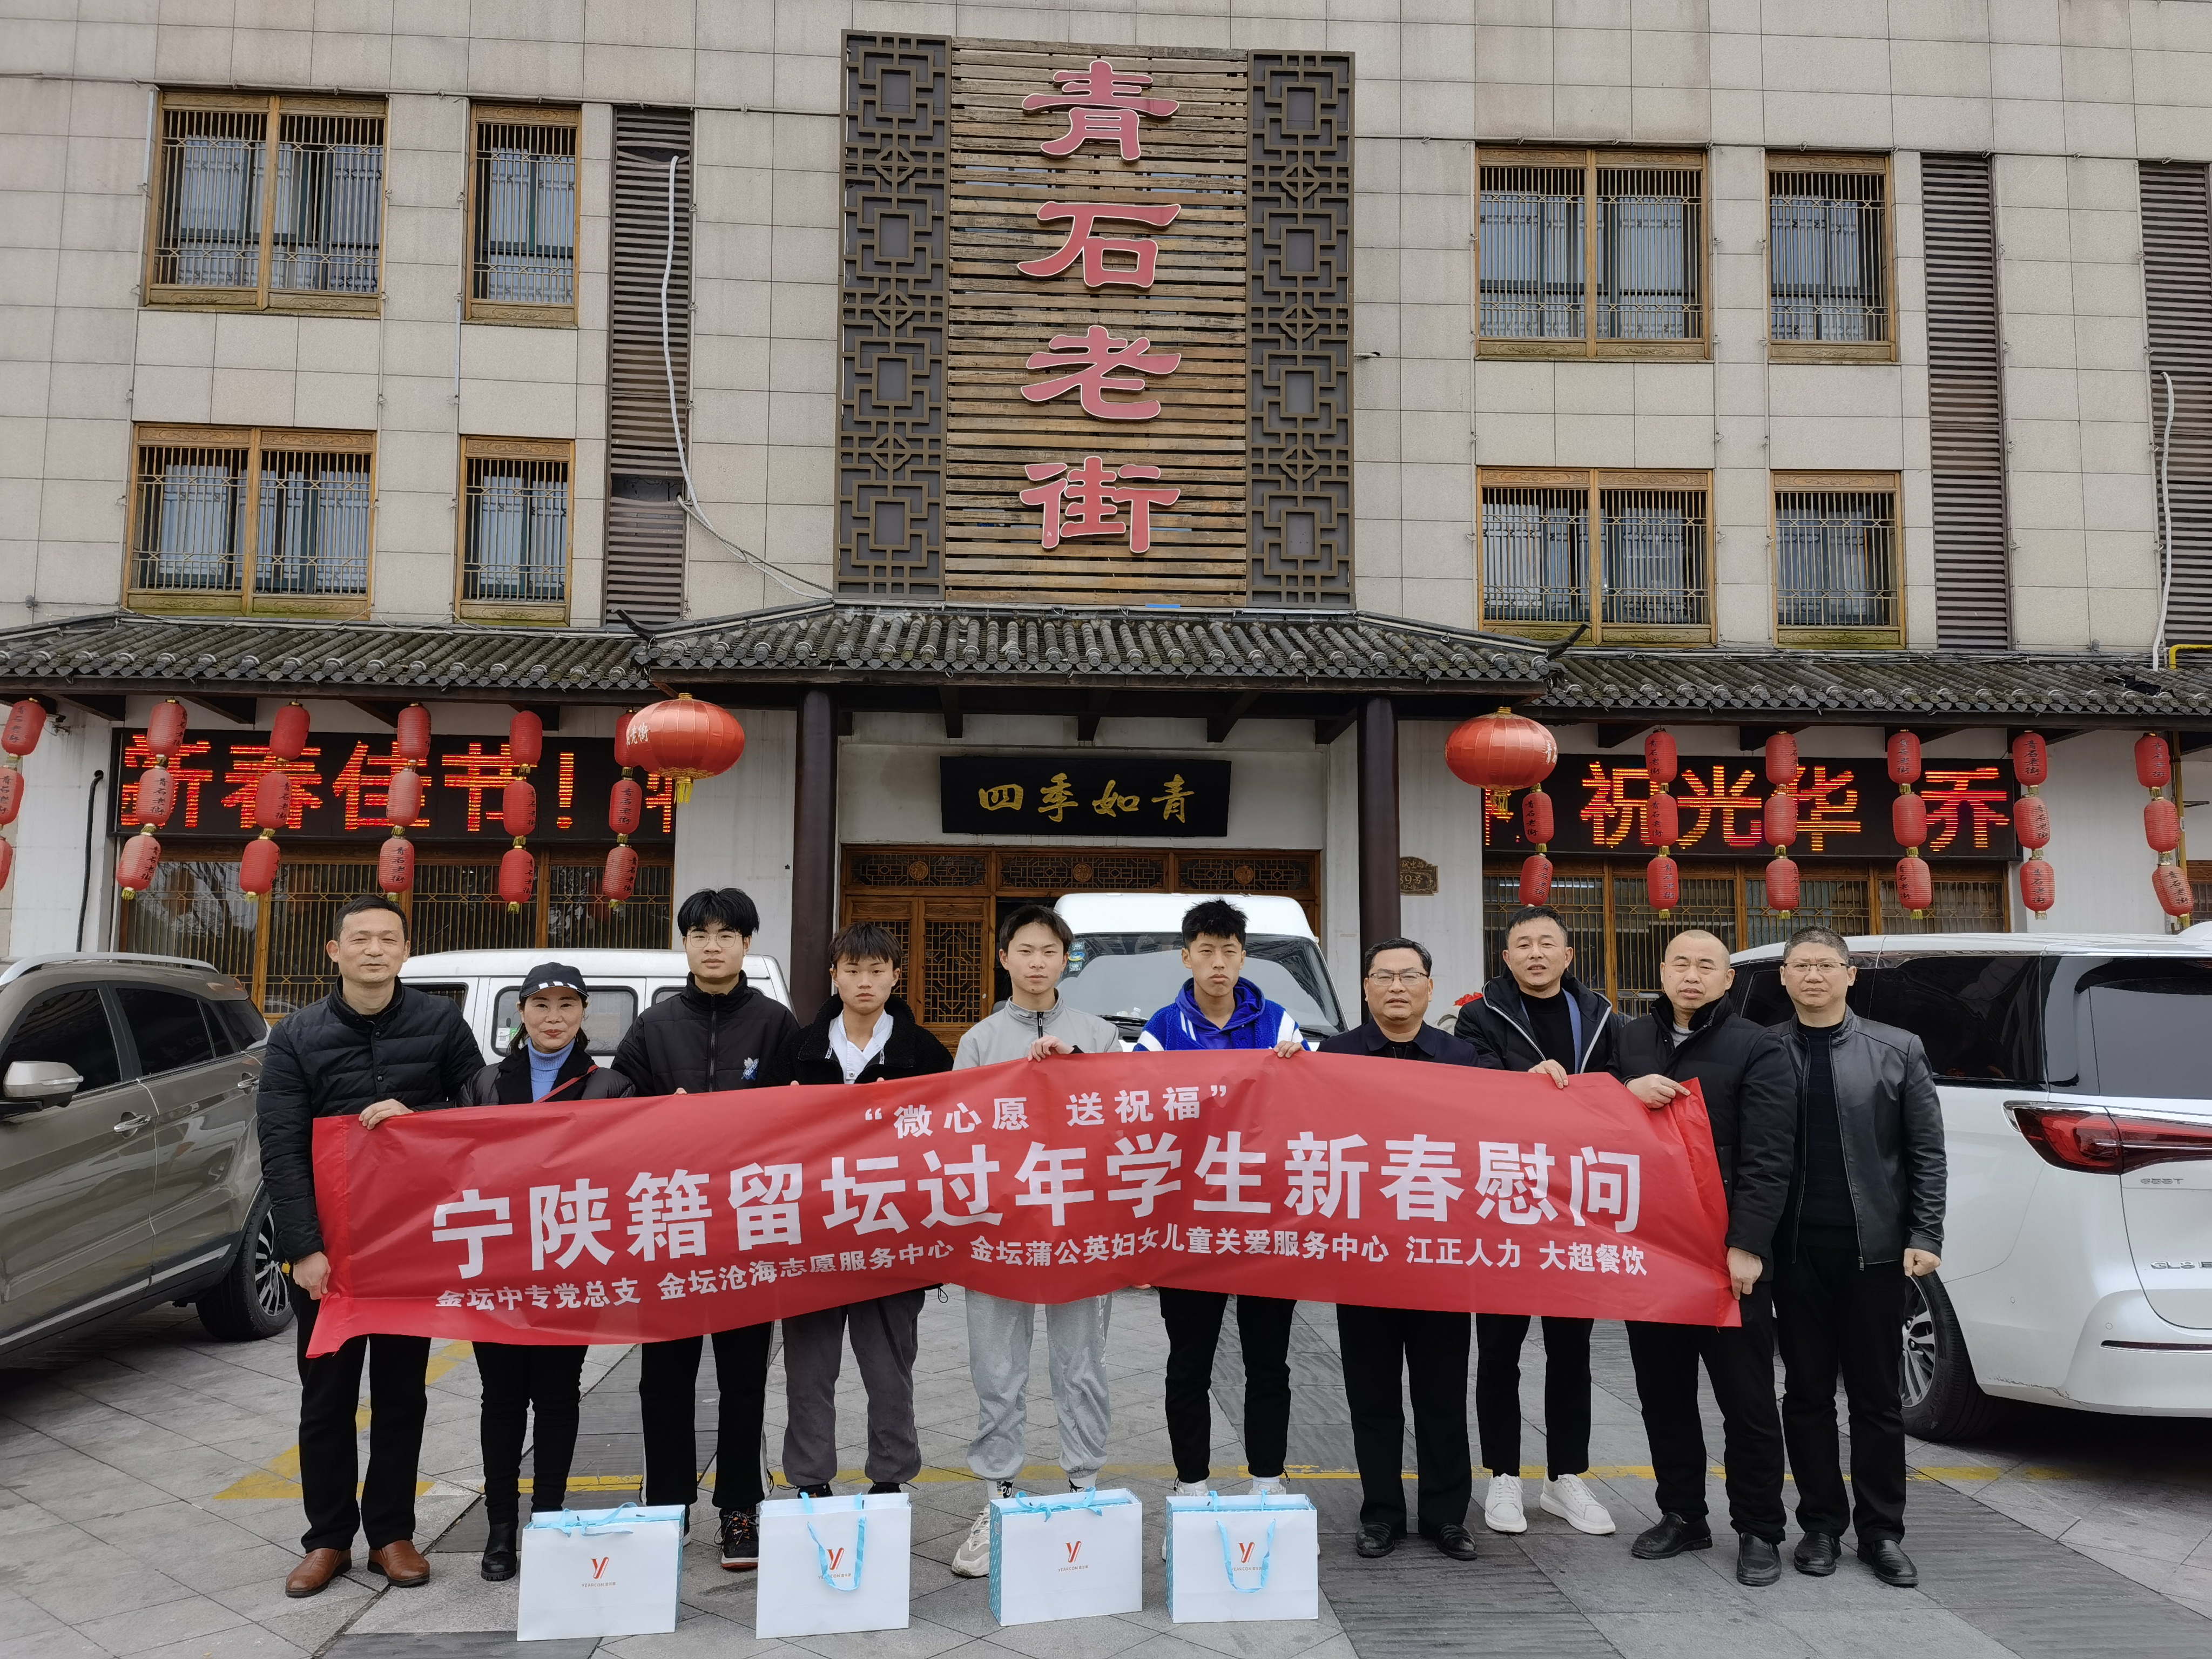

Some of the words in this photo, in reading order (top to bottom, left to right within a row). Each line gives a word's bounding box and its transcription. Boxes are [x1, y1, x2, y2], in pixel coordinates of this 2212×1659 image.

[1017, 60, 1182, 555] 青石老街
[1648, 739, 1662, 775] 青石老街
[150, 777, 167, 815] 青石老街
[275, 782, 291, 820] 青石老街
[618, 788, 633, 825] 青石老街
[978, 772, 1195, 823] 四季如青
[1525, 800, 1538, 837] 青石老街
[1650, 800, 1663, 837] 青石老街
[392, 846, 407, 884] 青石老街
[623, 857, 637, 892] 青石老街
[1898, 864, 1912, 900] 青石老街
[431, 1131, 1641, 1279] 宁陕籍留坛过年学生新春慰问
[435, 1277, 642, 1312] 金坛中专党总支
[656, 1239, 955, 1301] 金坛沧海志愿服务中心
[969, 1223, 1390, 1268] 金坛蒲公英妇女儿童关爱服务中心
[1406, 1235, 1521, 1269] 江正人力
[1538, 1240, 1648, 1277] 大超餐饮
